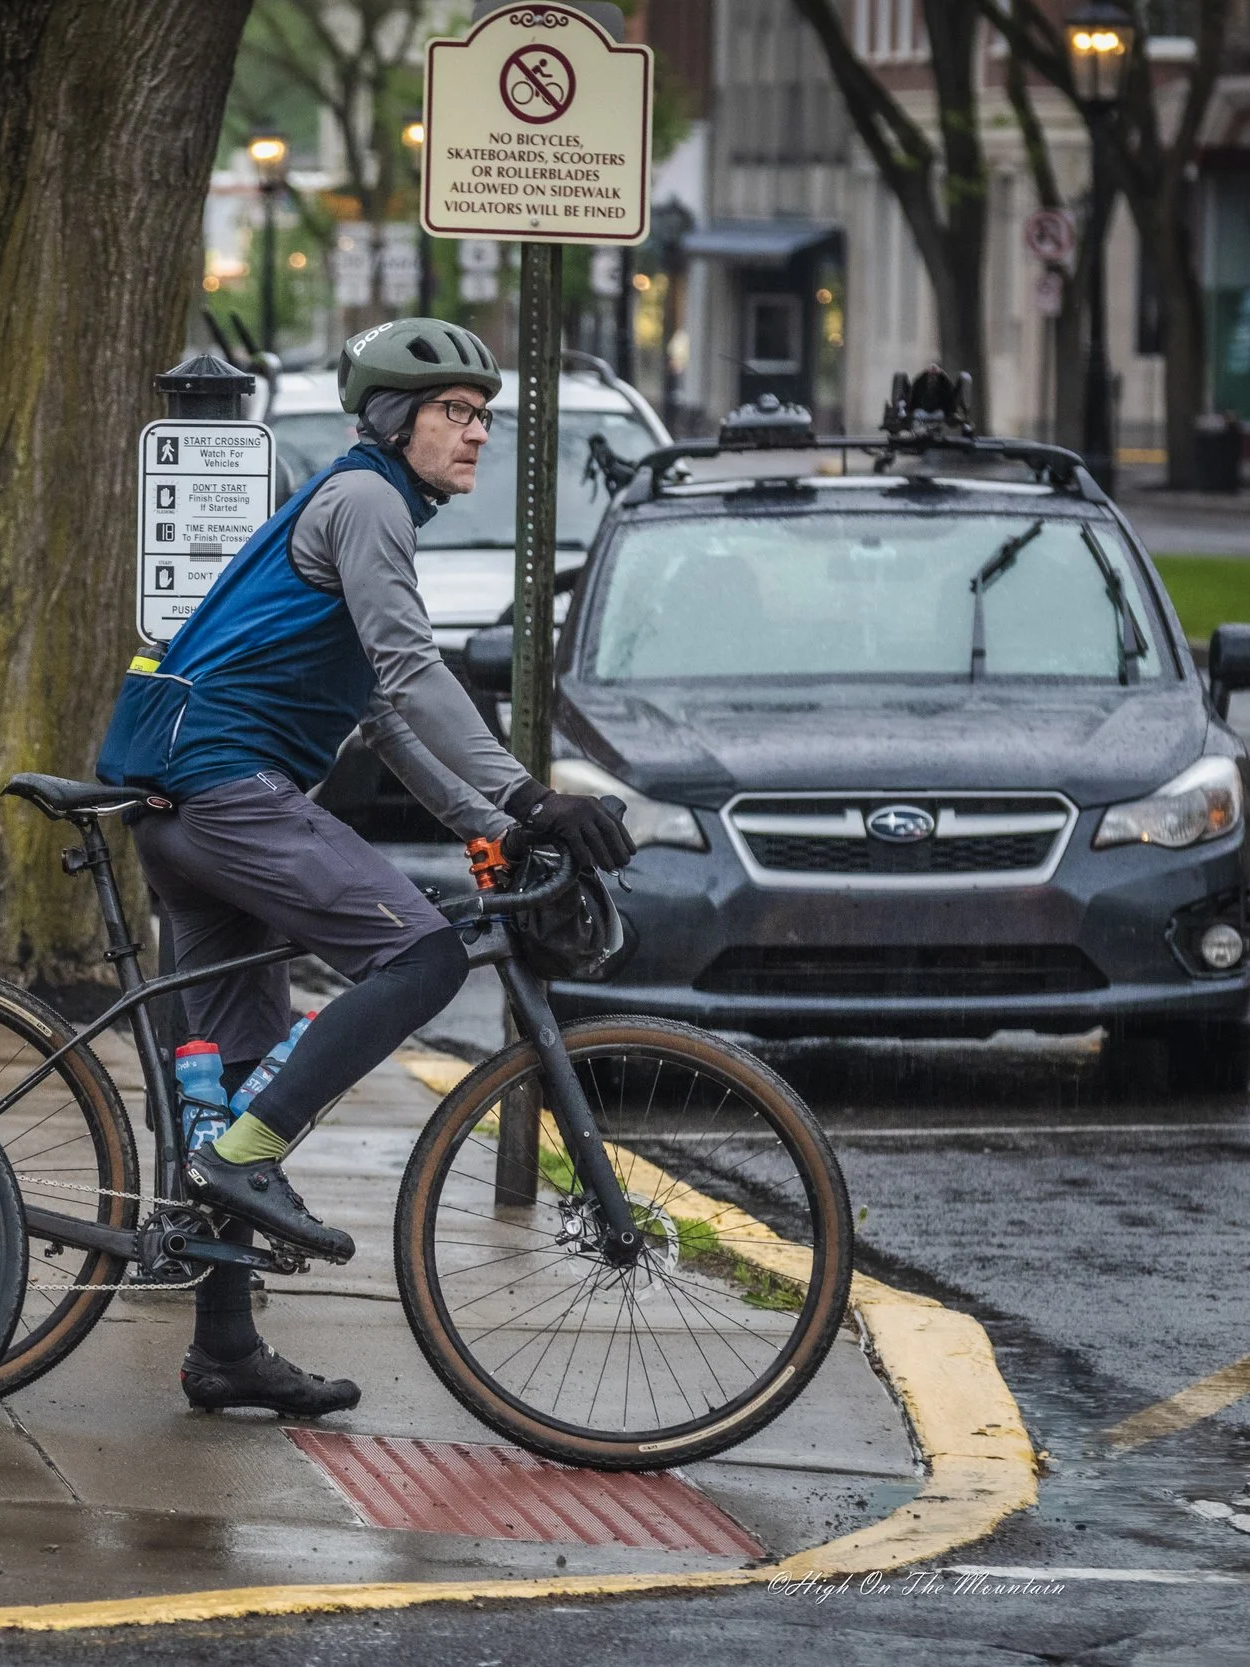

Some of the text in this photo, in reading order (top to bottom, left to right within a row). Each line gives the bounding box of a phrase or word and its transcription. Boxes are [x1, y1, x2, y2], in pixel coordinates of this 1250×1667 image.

[489, 132, 584, 149] NO BICYCLES,
[447, 148, 626, 166] SKATEBOARDS, SCOOTERS
[472, 165, 600, 181] OR ROLLERBLADES
[450, 182, 621, 199] ALLOWED ON SIDEWALK
[444, 200, 626, 219] VIOLATORS WILL BE FINED
[183, 437, 261, 446] START CROSSING
[200, 449, 244, 458] Watch For
[204, 459, 240, 468] Vehicles
[192, 484, 247, 492] DON'T START
[188, 494, 250, 504] Finish Crossing
[210, 504, 238, 512] Started
[186, 524, 254, 533] TIME REMAINING
[182, 534, 192, 542] To
[194, 534, 218, 542] Finish
[188, 572, 214, 580] DON'T
